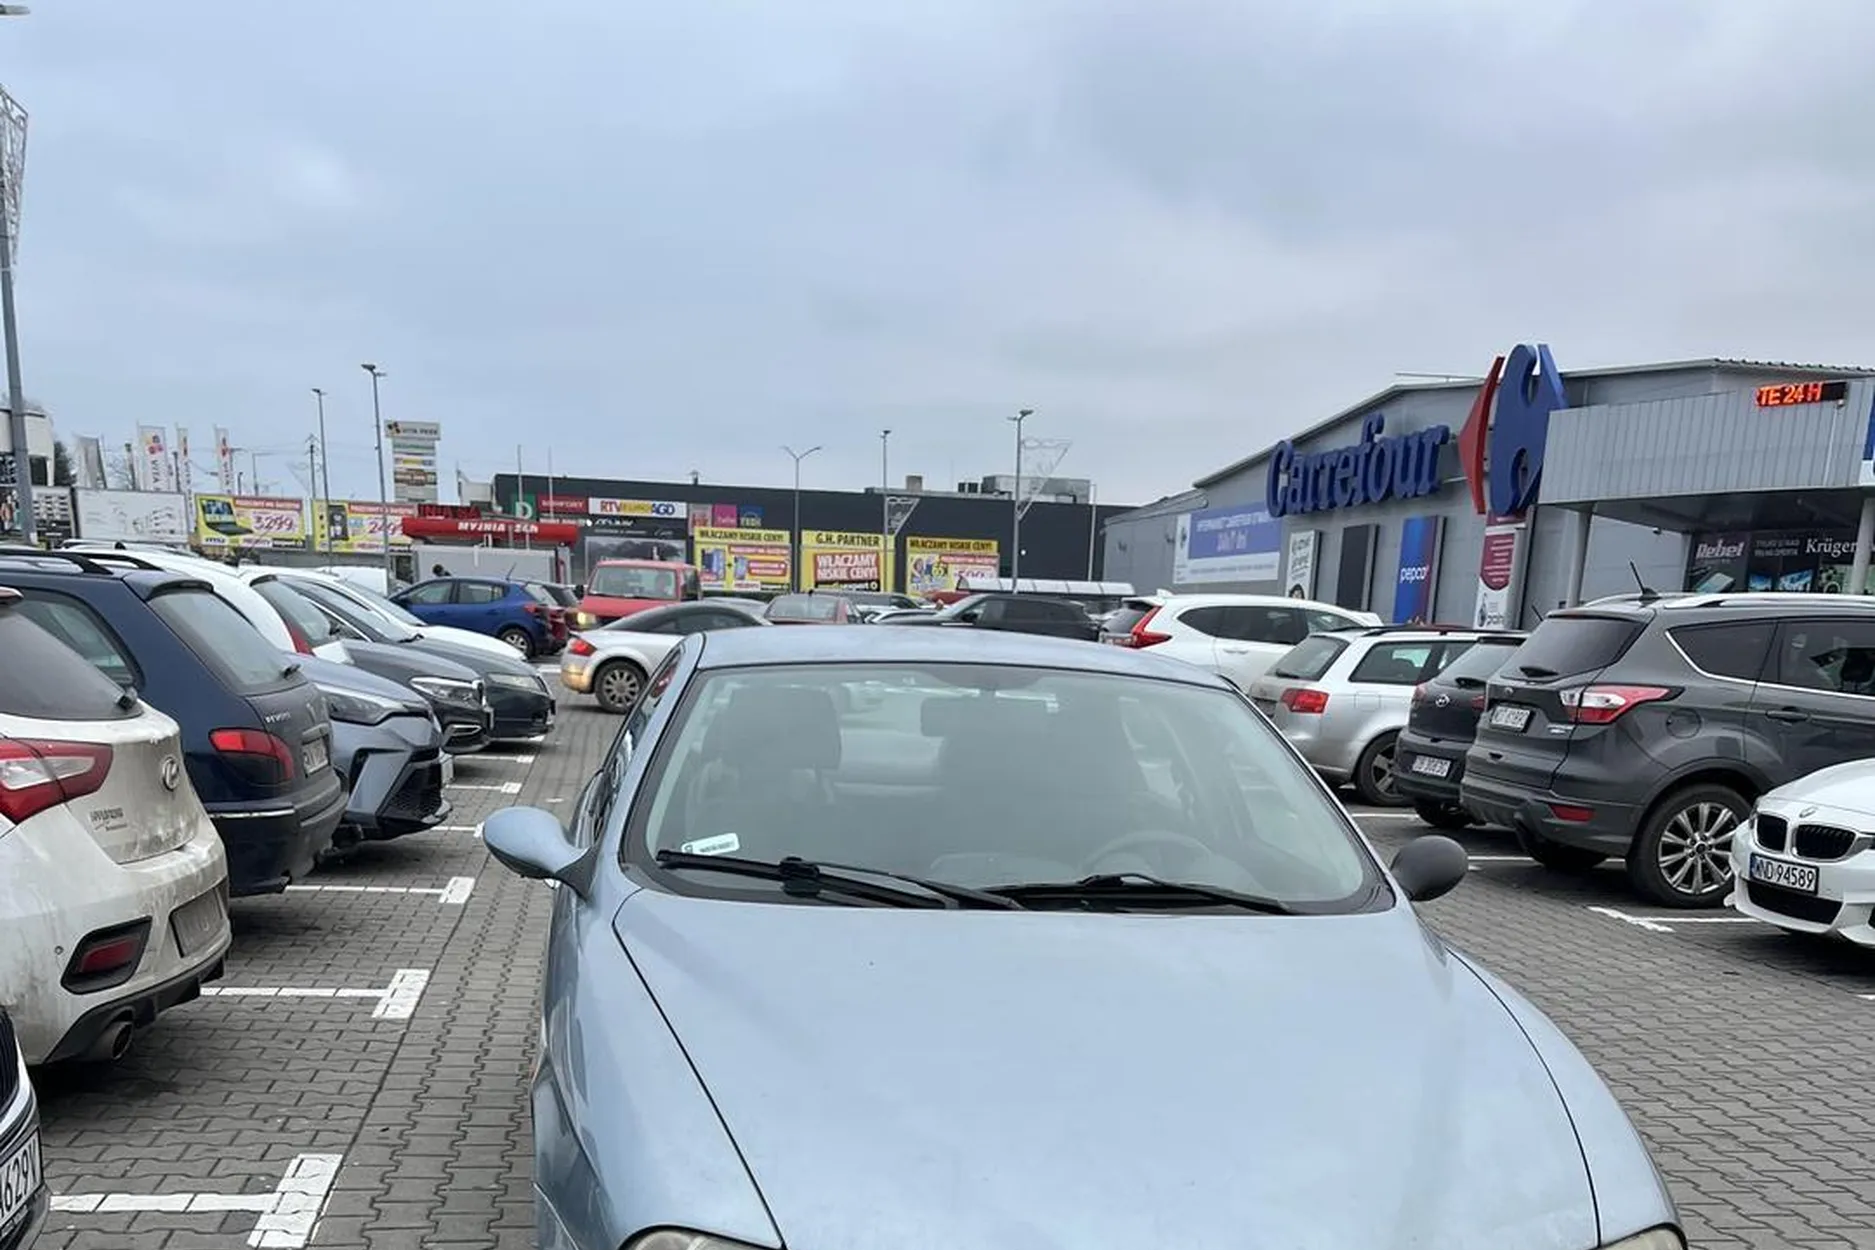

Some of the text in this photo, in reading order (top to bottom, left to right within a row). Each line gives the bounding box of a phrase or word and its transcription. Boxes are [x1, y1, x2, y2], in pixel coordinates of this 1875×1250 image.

[1756, 386, 1780, 405] TE
[1266, 412, 1450, 517] Carrefour
[837, 534, 880, 546] PARTNER
[1806, 537, 1859, 557] Krüger
[1400, 567, 1427, 584] pepco
[1777, 864, 1815, 888] 94589
